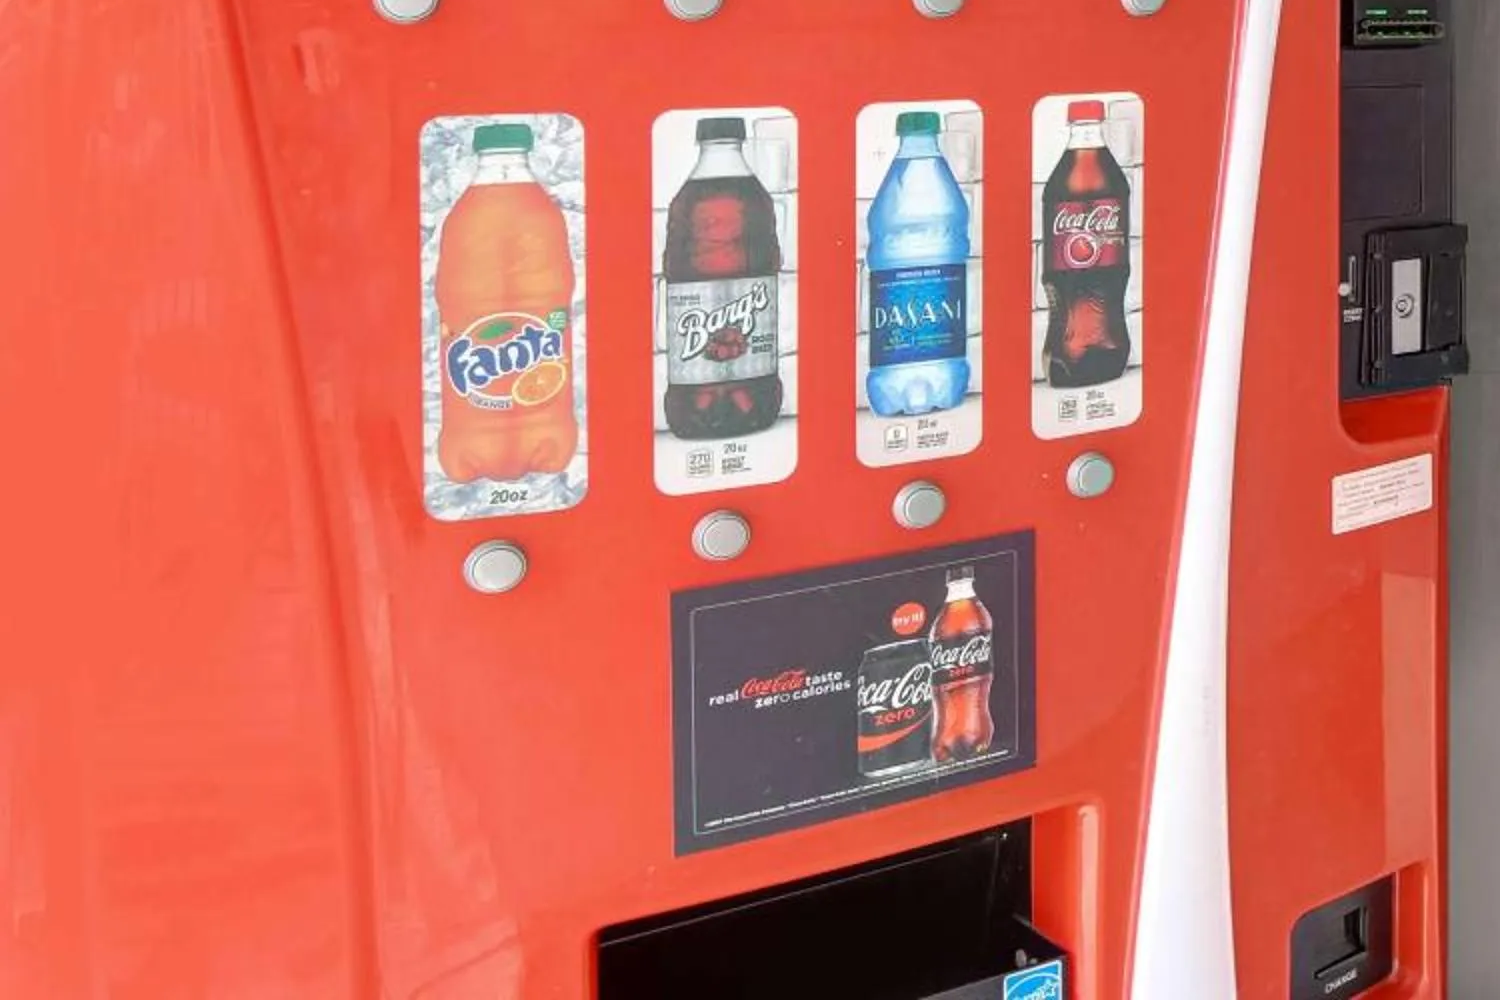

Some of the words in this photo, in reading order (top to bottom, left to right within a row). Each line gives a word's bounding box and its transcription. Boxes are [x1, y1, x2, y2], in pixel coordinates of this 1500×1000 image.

[1053, 205, 1121, 234] Coca-Cola
[678, 282, 769, 361] Barq's
[875, 299, 961, 328] DASANI
[448, 324, 561, 395] Fanta
[709, 690, 739, 706] real
[741, 669, 806, 699] Coca-Cola
[805, 671, 843, 687] taste
[755, 694, 790, 709] zero
[793, 680, 851, 700] calories
[873, 707, 916, 726] zero
